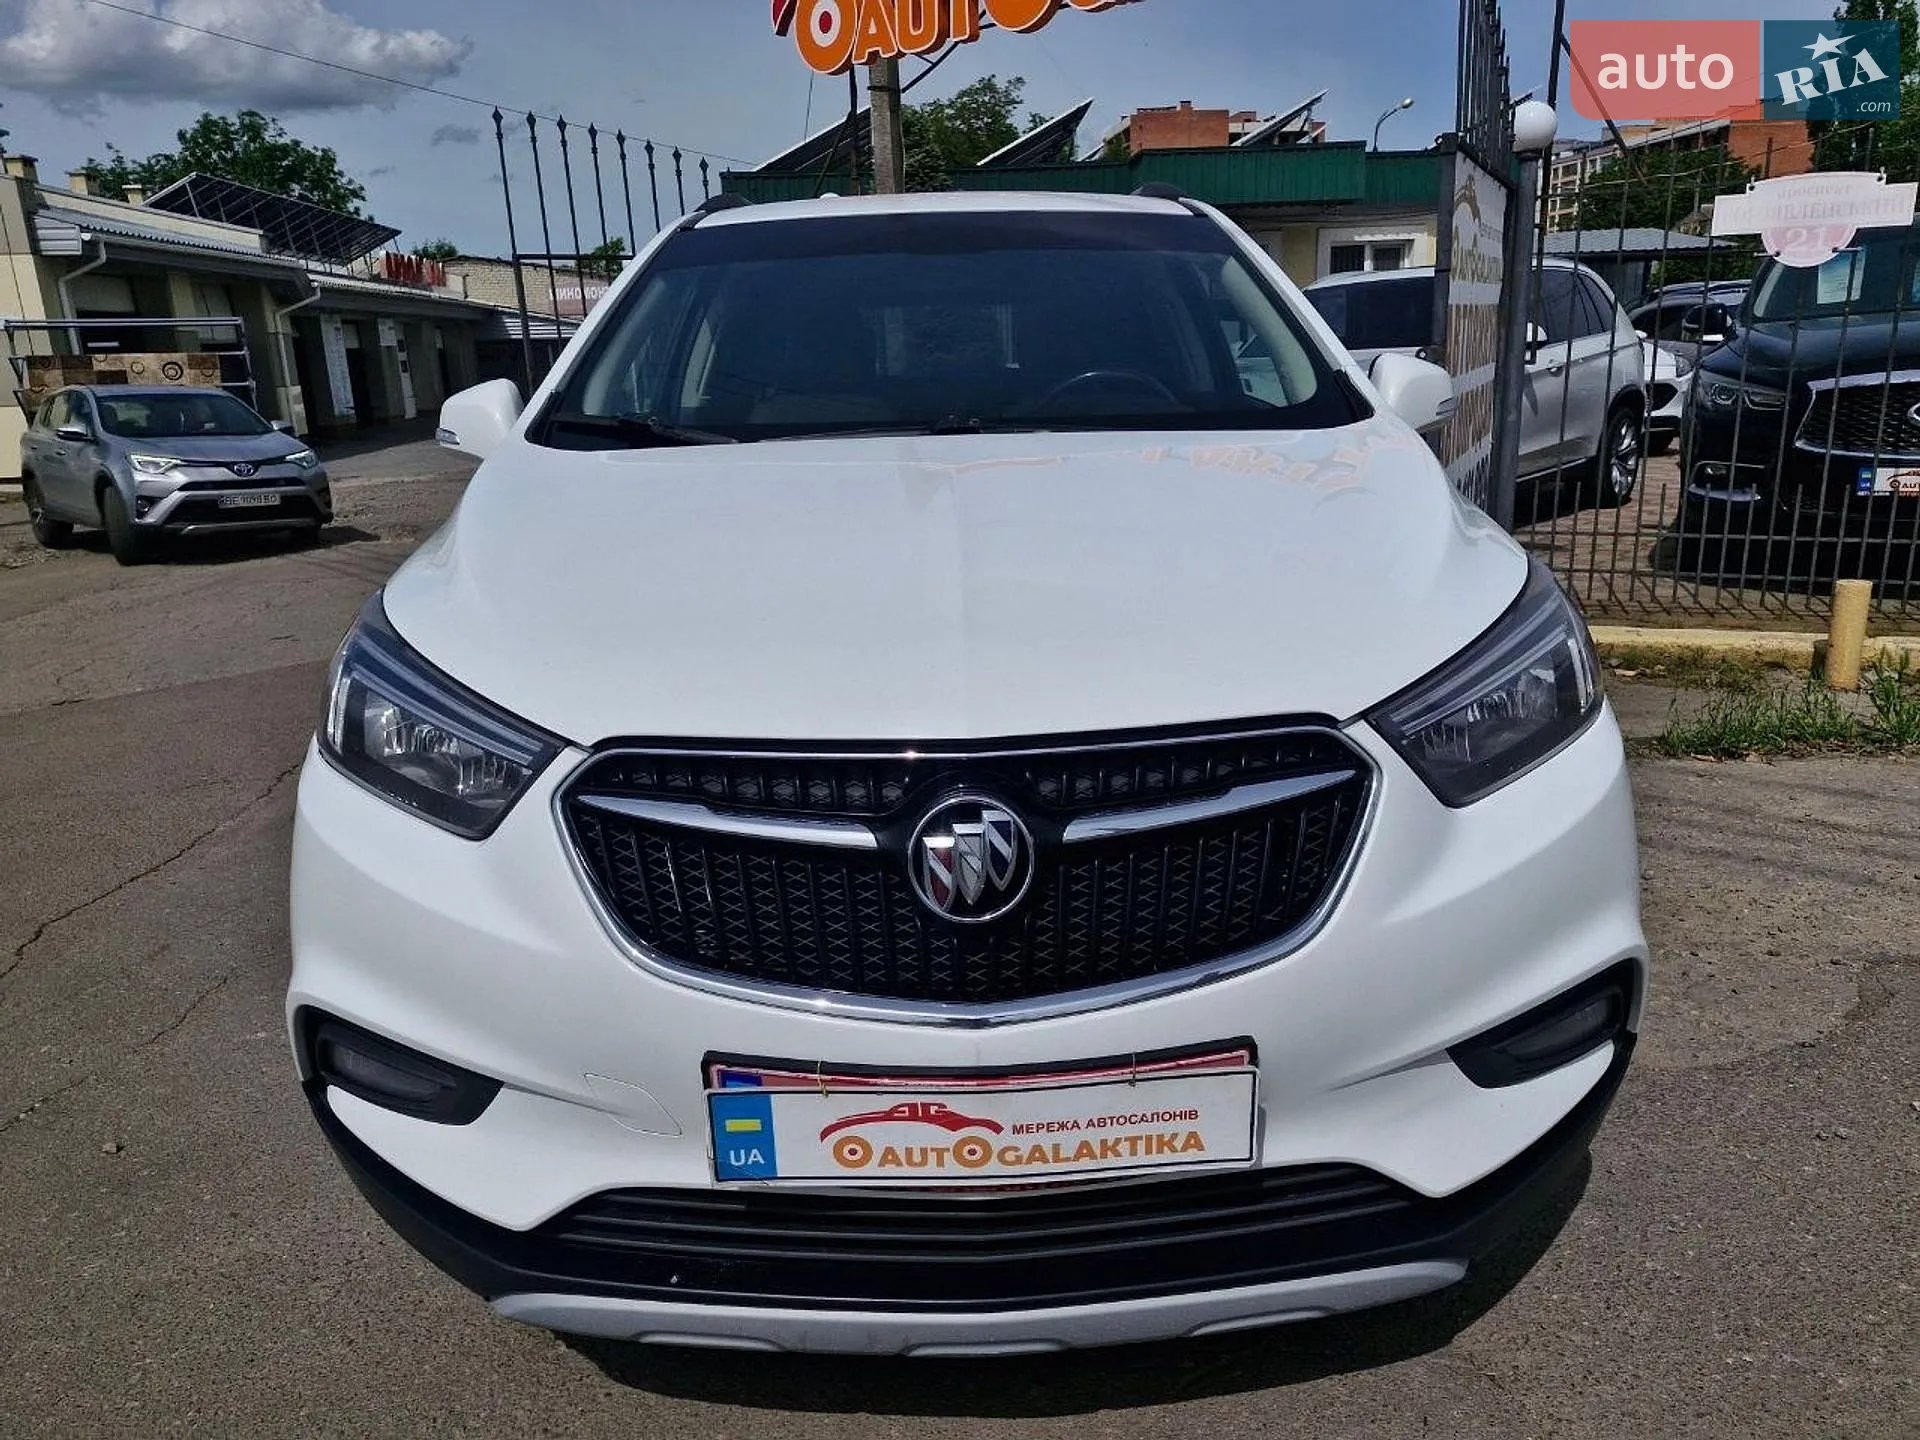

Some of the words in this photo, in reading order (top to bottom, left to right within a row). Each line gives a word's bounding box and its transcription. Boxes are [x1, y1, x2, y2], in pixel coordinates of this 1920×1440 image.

[1785, 226, 1830, 249] 21
[1012, 1119, 1081, 1135] МЕРЕЖА
[1085, 1109, 1199, 1129] АВТОСАЛОНІВ
[729, 1148, 765, 1166] UA
